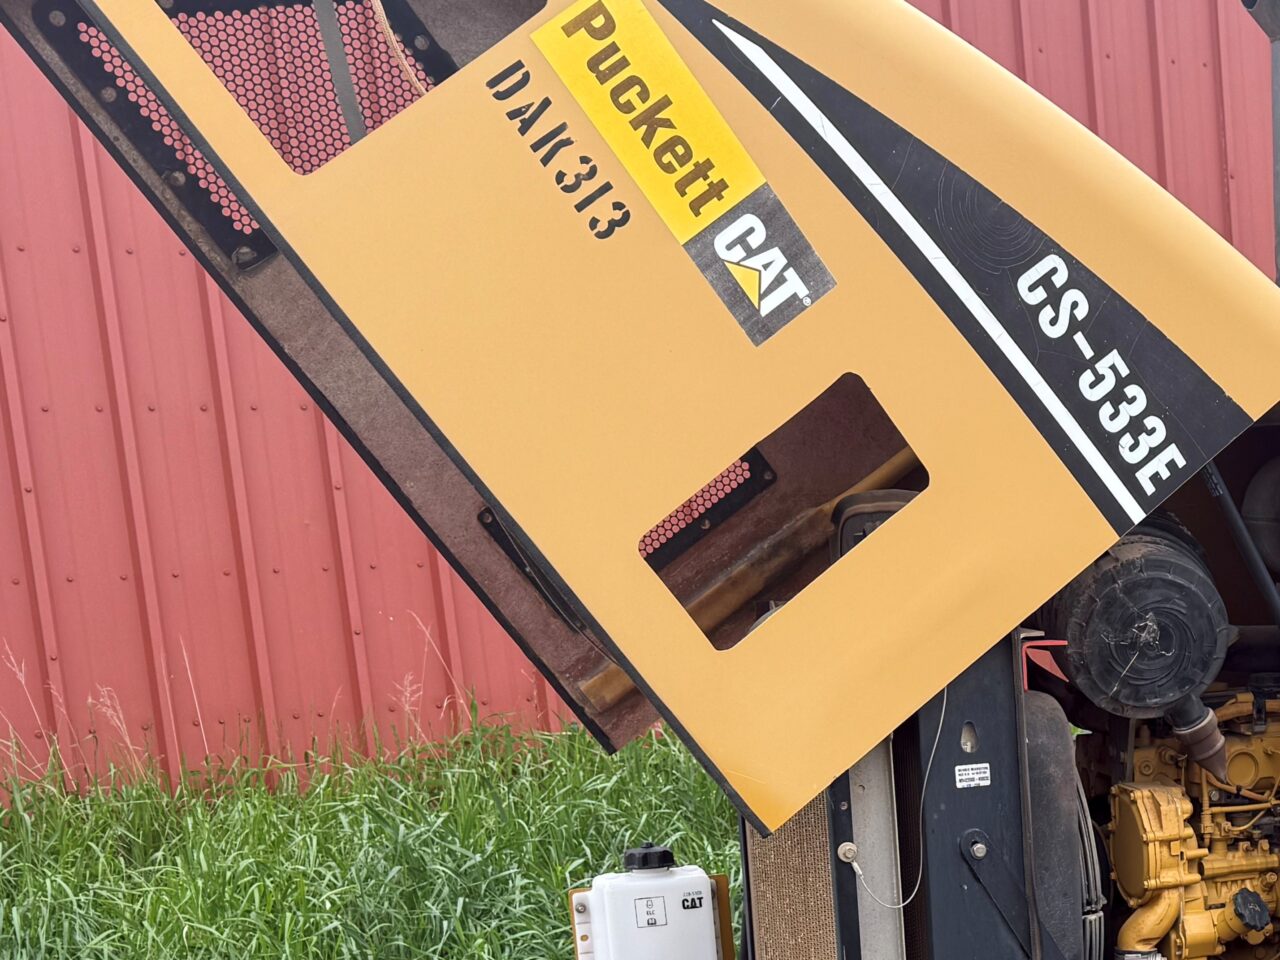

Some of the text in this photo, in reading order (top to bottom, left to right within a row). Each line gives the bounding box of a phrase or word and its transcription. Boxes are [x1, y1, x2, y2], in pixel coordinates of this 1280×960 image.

[561, 1, 730, 217] Puckett
[713, 213, 810, 318] CAT
[1017, 252, 1188, 495] CS-533E
[681, 897, 703, 910] CAT
